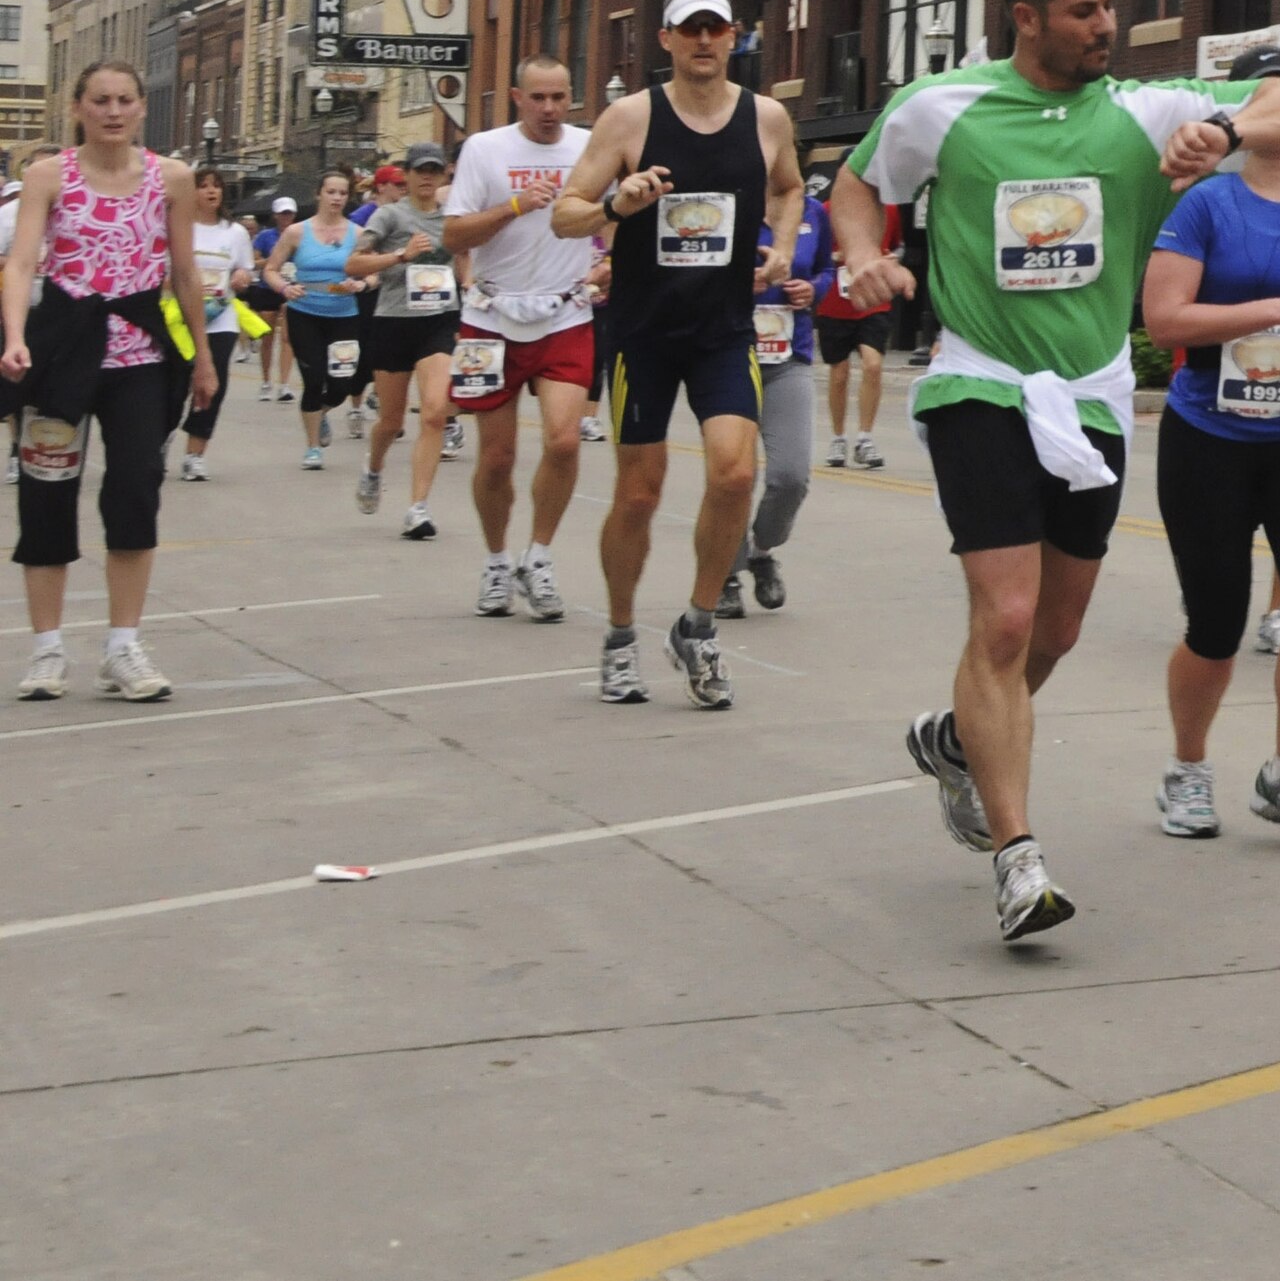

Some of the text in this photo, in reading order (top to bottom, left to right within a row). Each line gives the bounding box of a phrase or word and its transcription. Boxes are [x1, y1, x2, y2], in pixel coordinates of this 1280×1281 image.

[356, 38, 459, 63] Banner
[1032, 181, 1090, 192] MARATHON
[680, 240, 708, 252] 251
[1023, 249, 1078, 269] 2612
